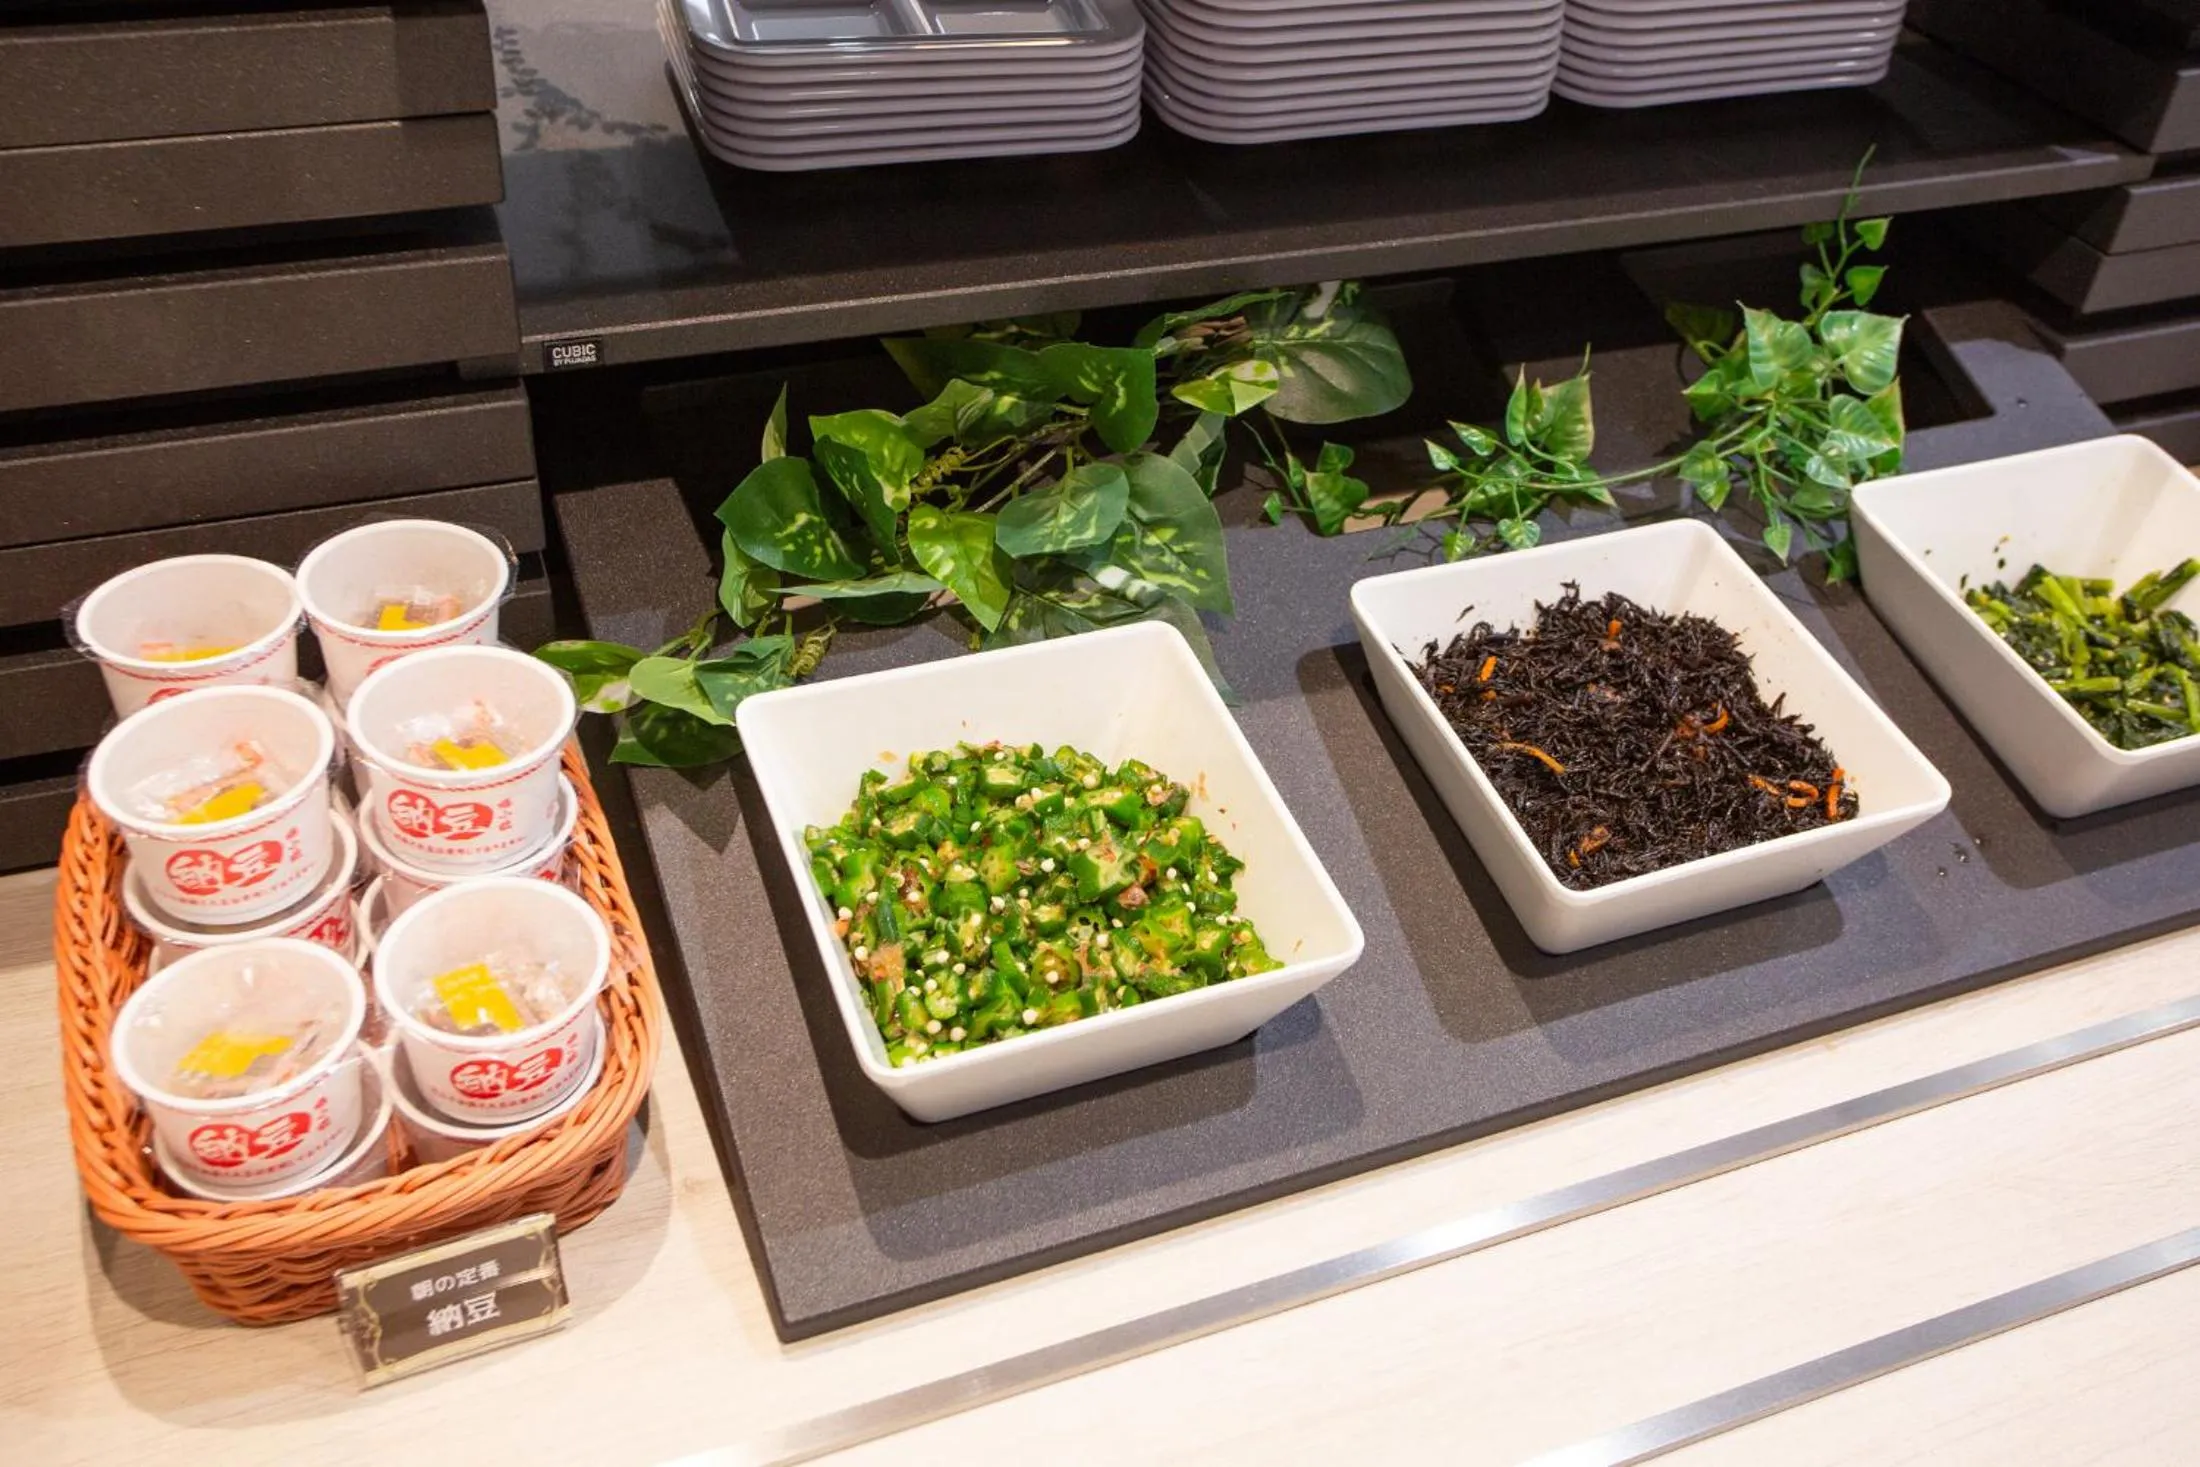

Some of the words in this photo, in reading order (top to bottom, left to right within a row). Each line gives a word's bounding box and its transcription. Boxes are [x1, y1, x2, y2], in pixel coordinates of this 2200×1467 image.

[552, 343, 596, 359] CUBIC
[388, 789, 493, 840] 納豆
[166, 840, 283, 896] 納豆
[450, 1047, 563, 1098] 納豆
[189, 1112, 311, 1168] 納豆
[410, 1259, 500, 1301] 朝の定番
[426, 1291, 502, 1336] 納豆
